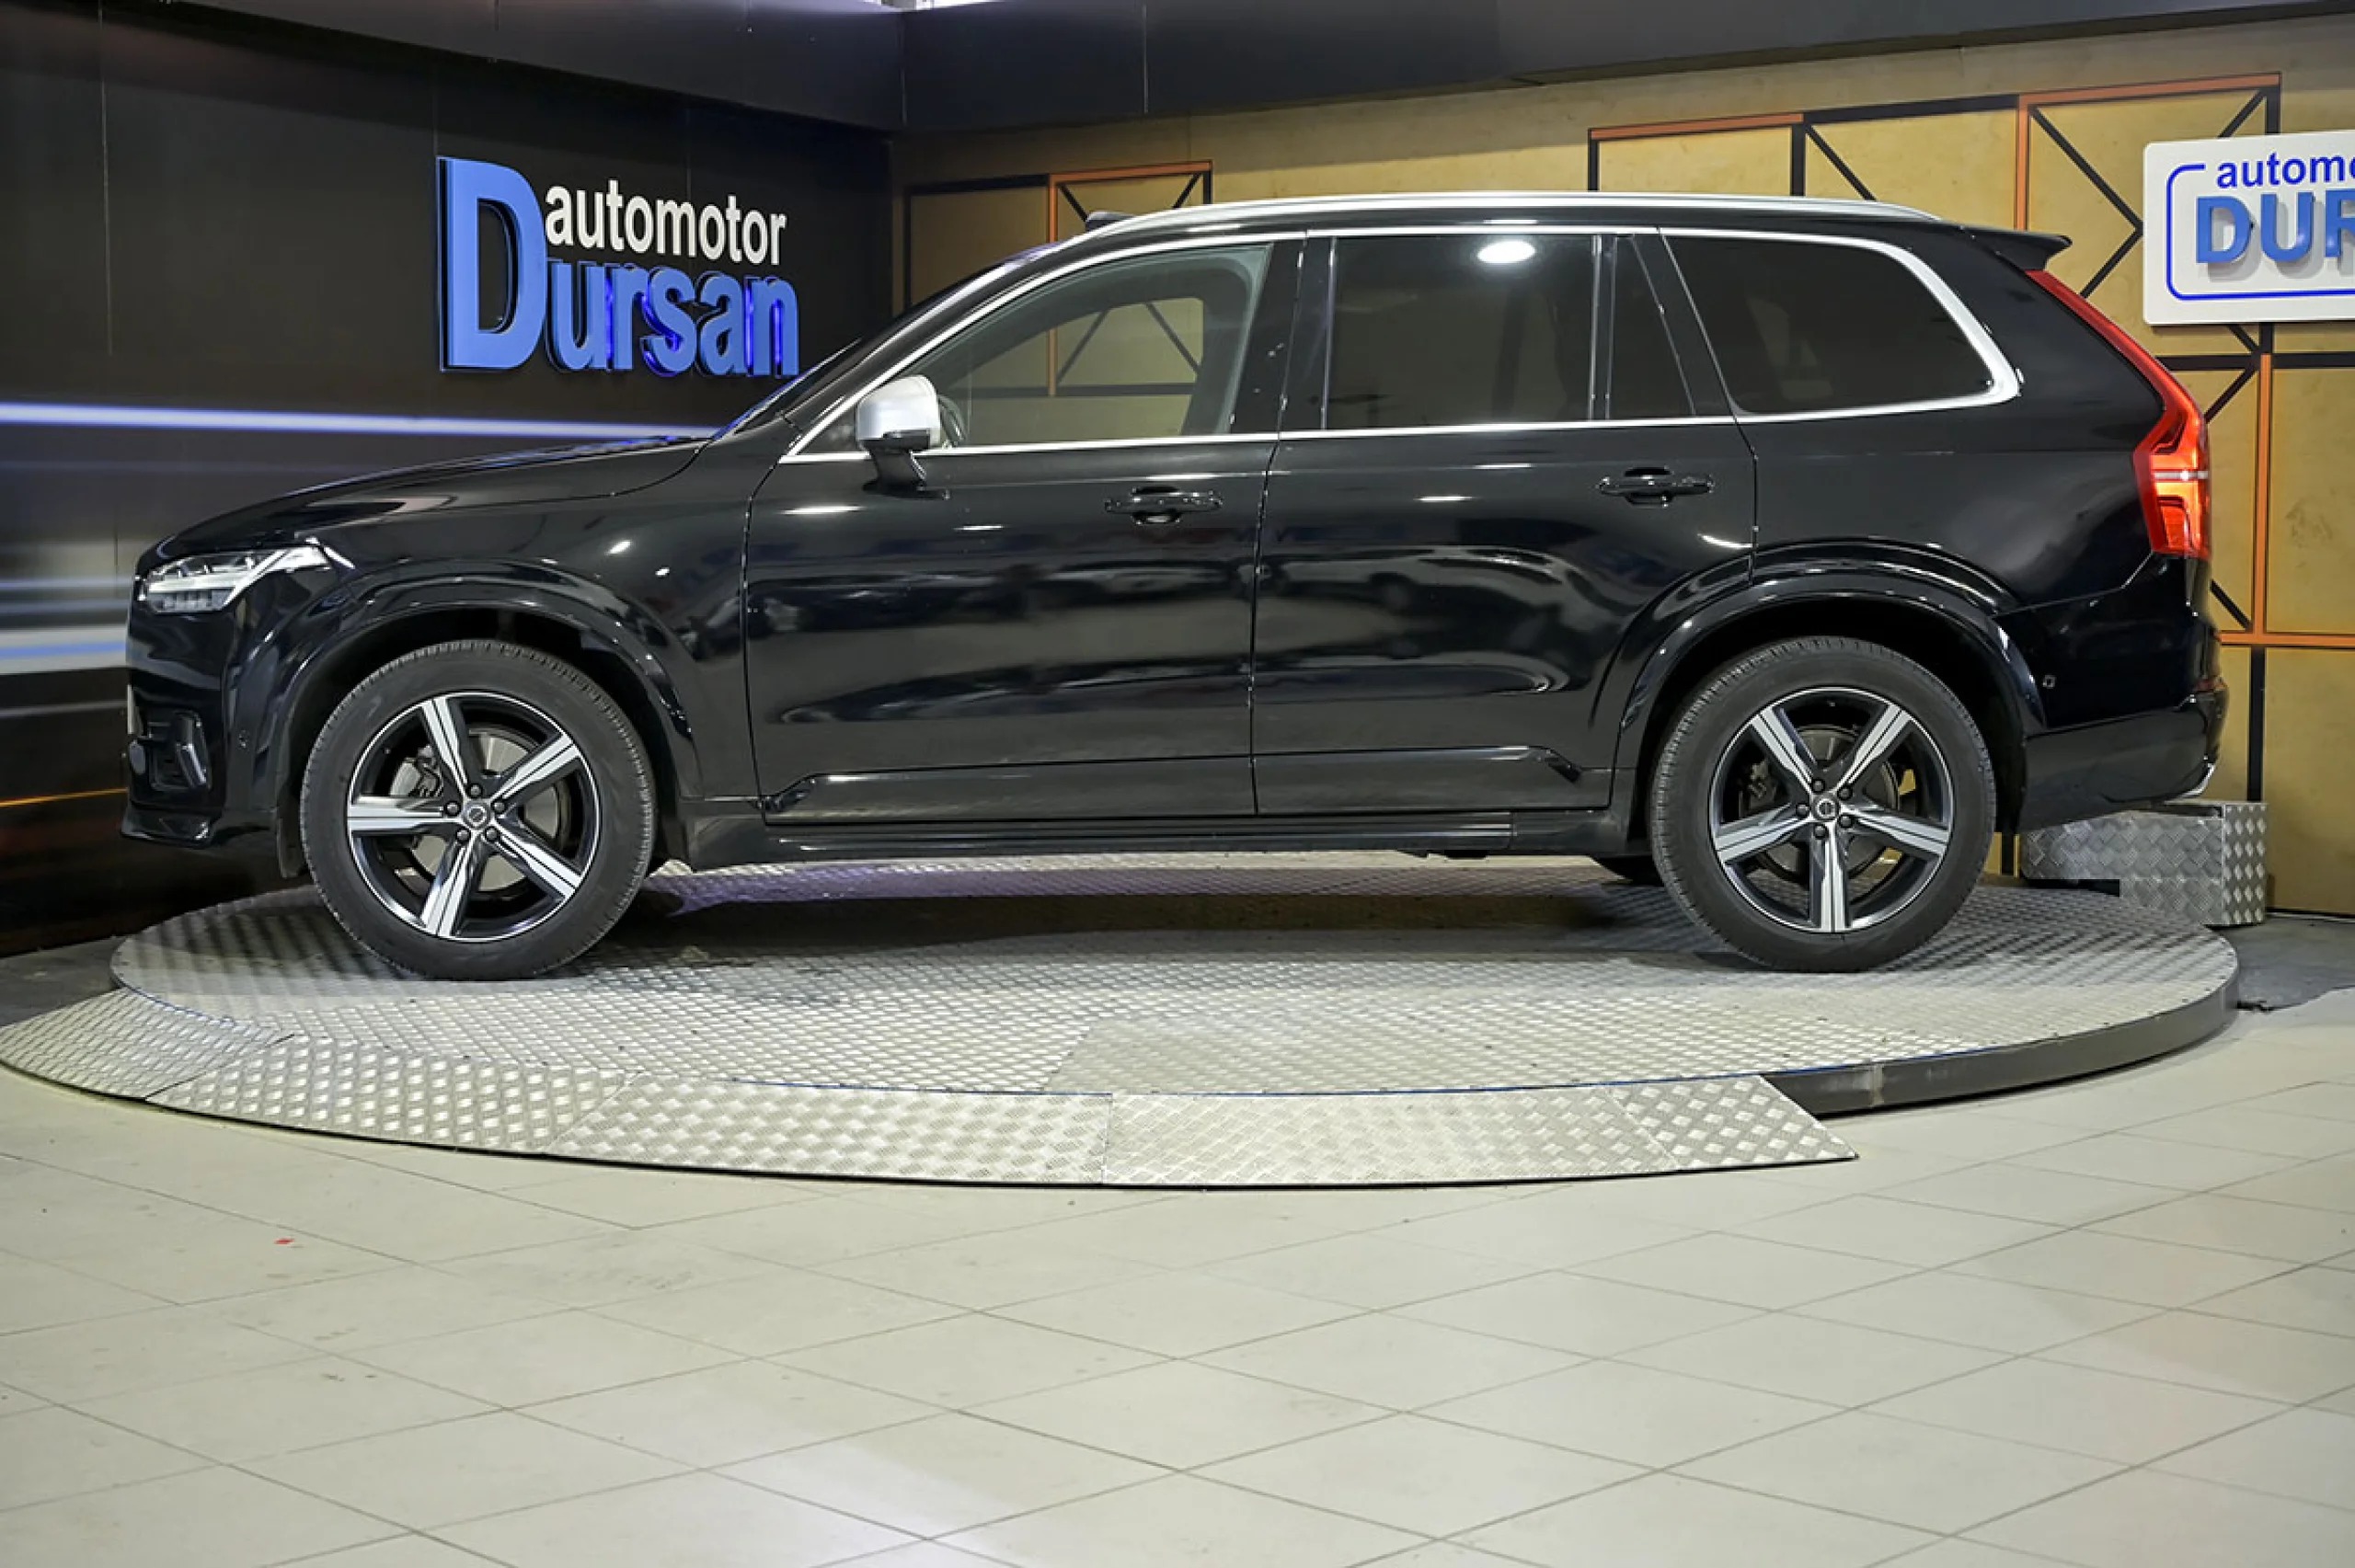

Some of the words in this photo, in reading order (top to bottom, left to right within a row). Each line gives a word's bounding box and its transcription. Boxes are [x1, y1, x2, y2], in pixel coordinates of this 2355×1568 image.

[2216, 152, 2355, 189] autom
[545, 179, 787, 265] automotor
[437, 156, 799, 376] Dursan
